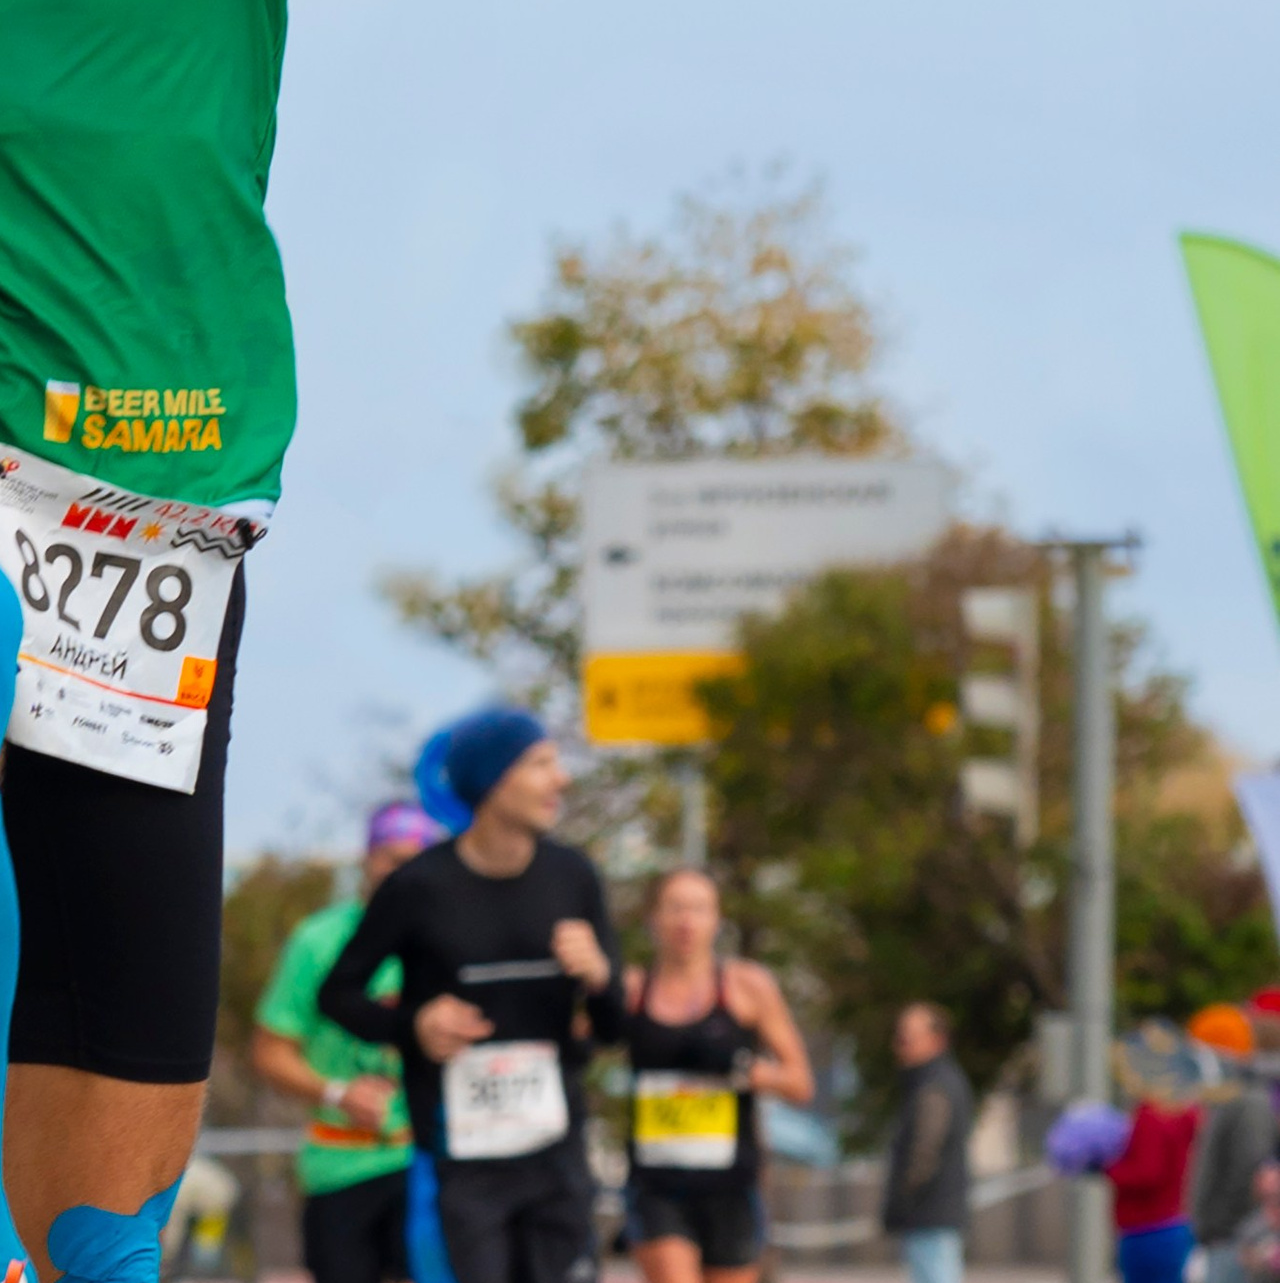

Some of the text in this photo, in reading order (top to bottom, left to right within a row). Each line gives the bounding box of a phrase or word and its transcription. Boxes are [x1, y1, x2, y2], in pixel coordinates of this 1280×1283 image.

[84, 385, 227, 417] BEER MILE
[81, 414, 222, 453] SAMARA
[15, 529, 193, 653] 8278
